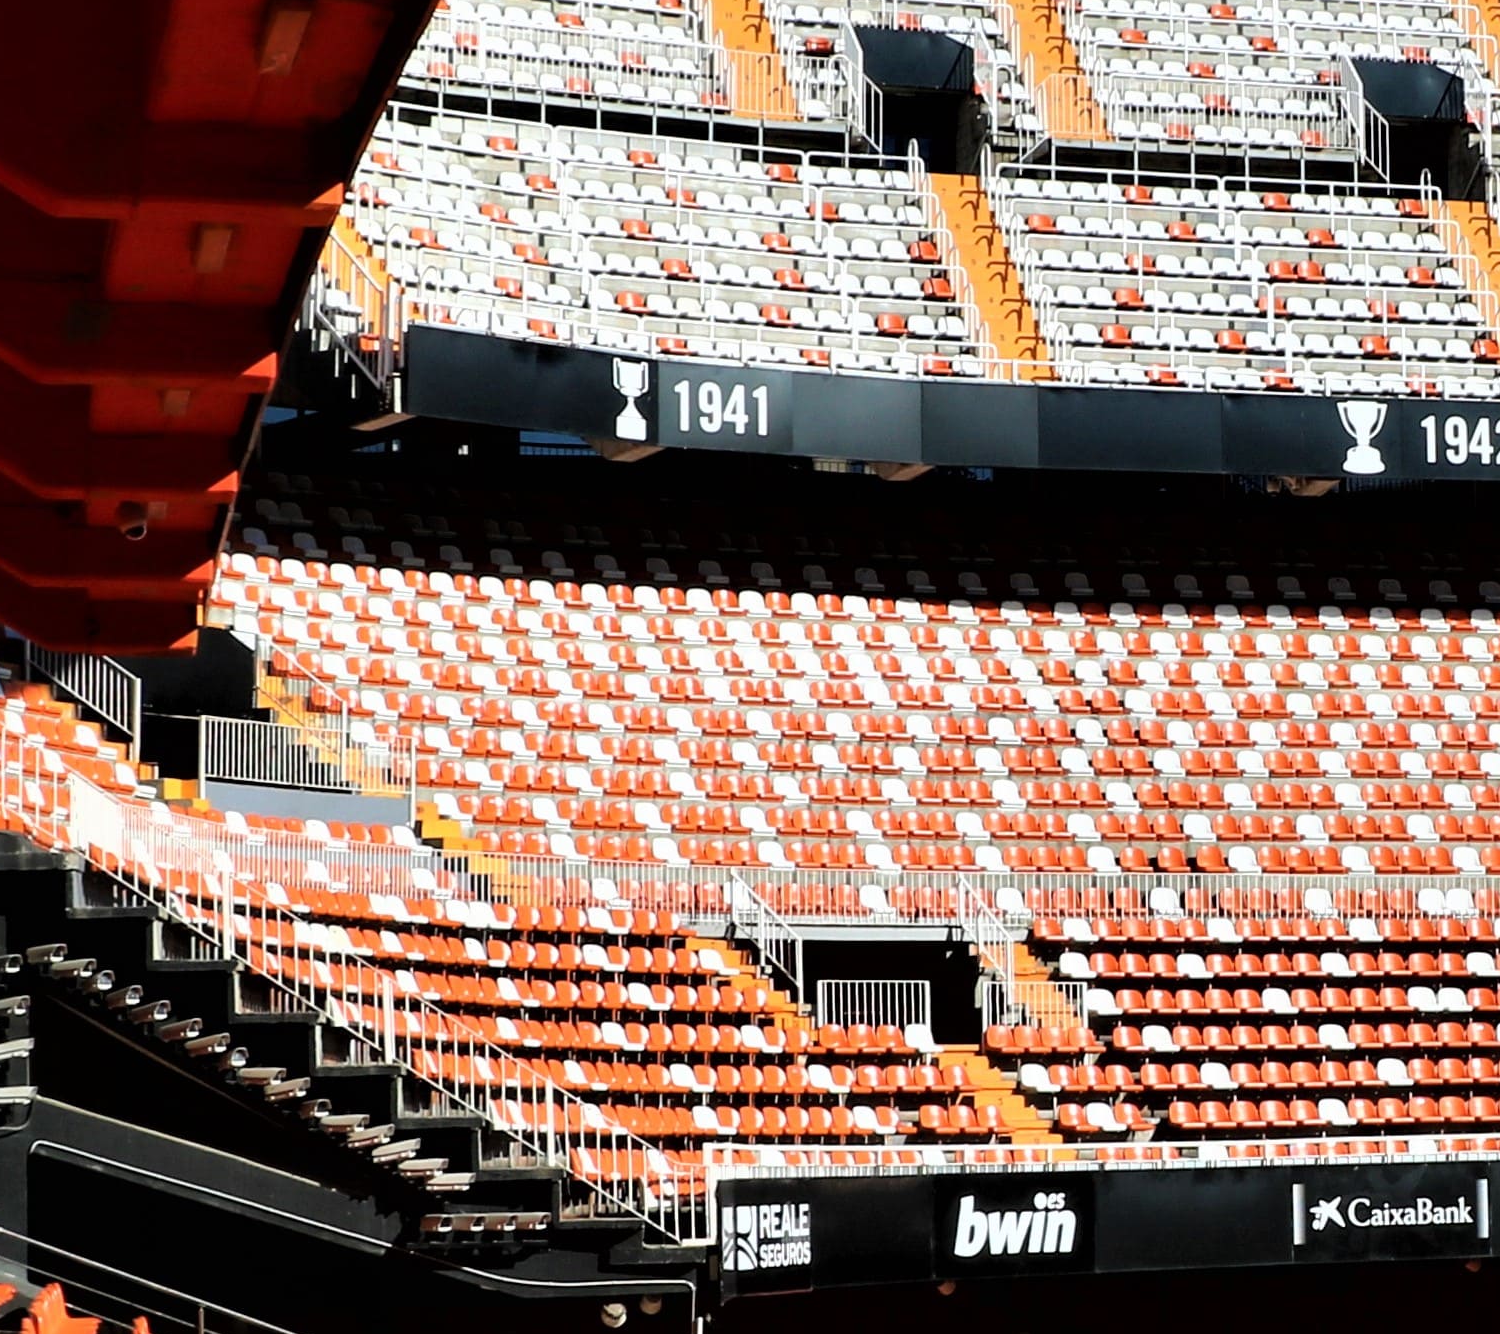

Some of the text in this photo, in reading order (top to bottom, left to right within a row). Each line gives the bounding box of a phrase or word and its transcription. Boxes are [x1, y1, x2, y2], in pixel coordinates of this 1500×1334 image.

[674, 378, 769, 436] 1941
[759, 1203, 811, 1238] REALE
[1348, 1196, 1474, 1228] CaixaBank
[759, 1241, 812, 1269] SEGUROS
